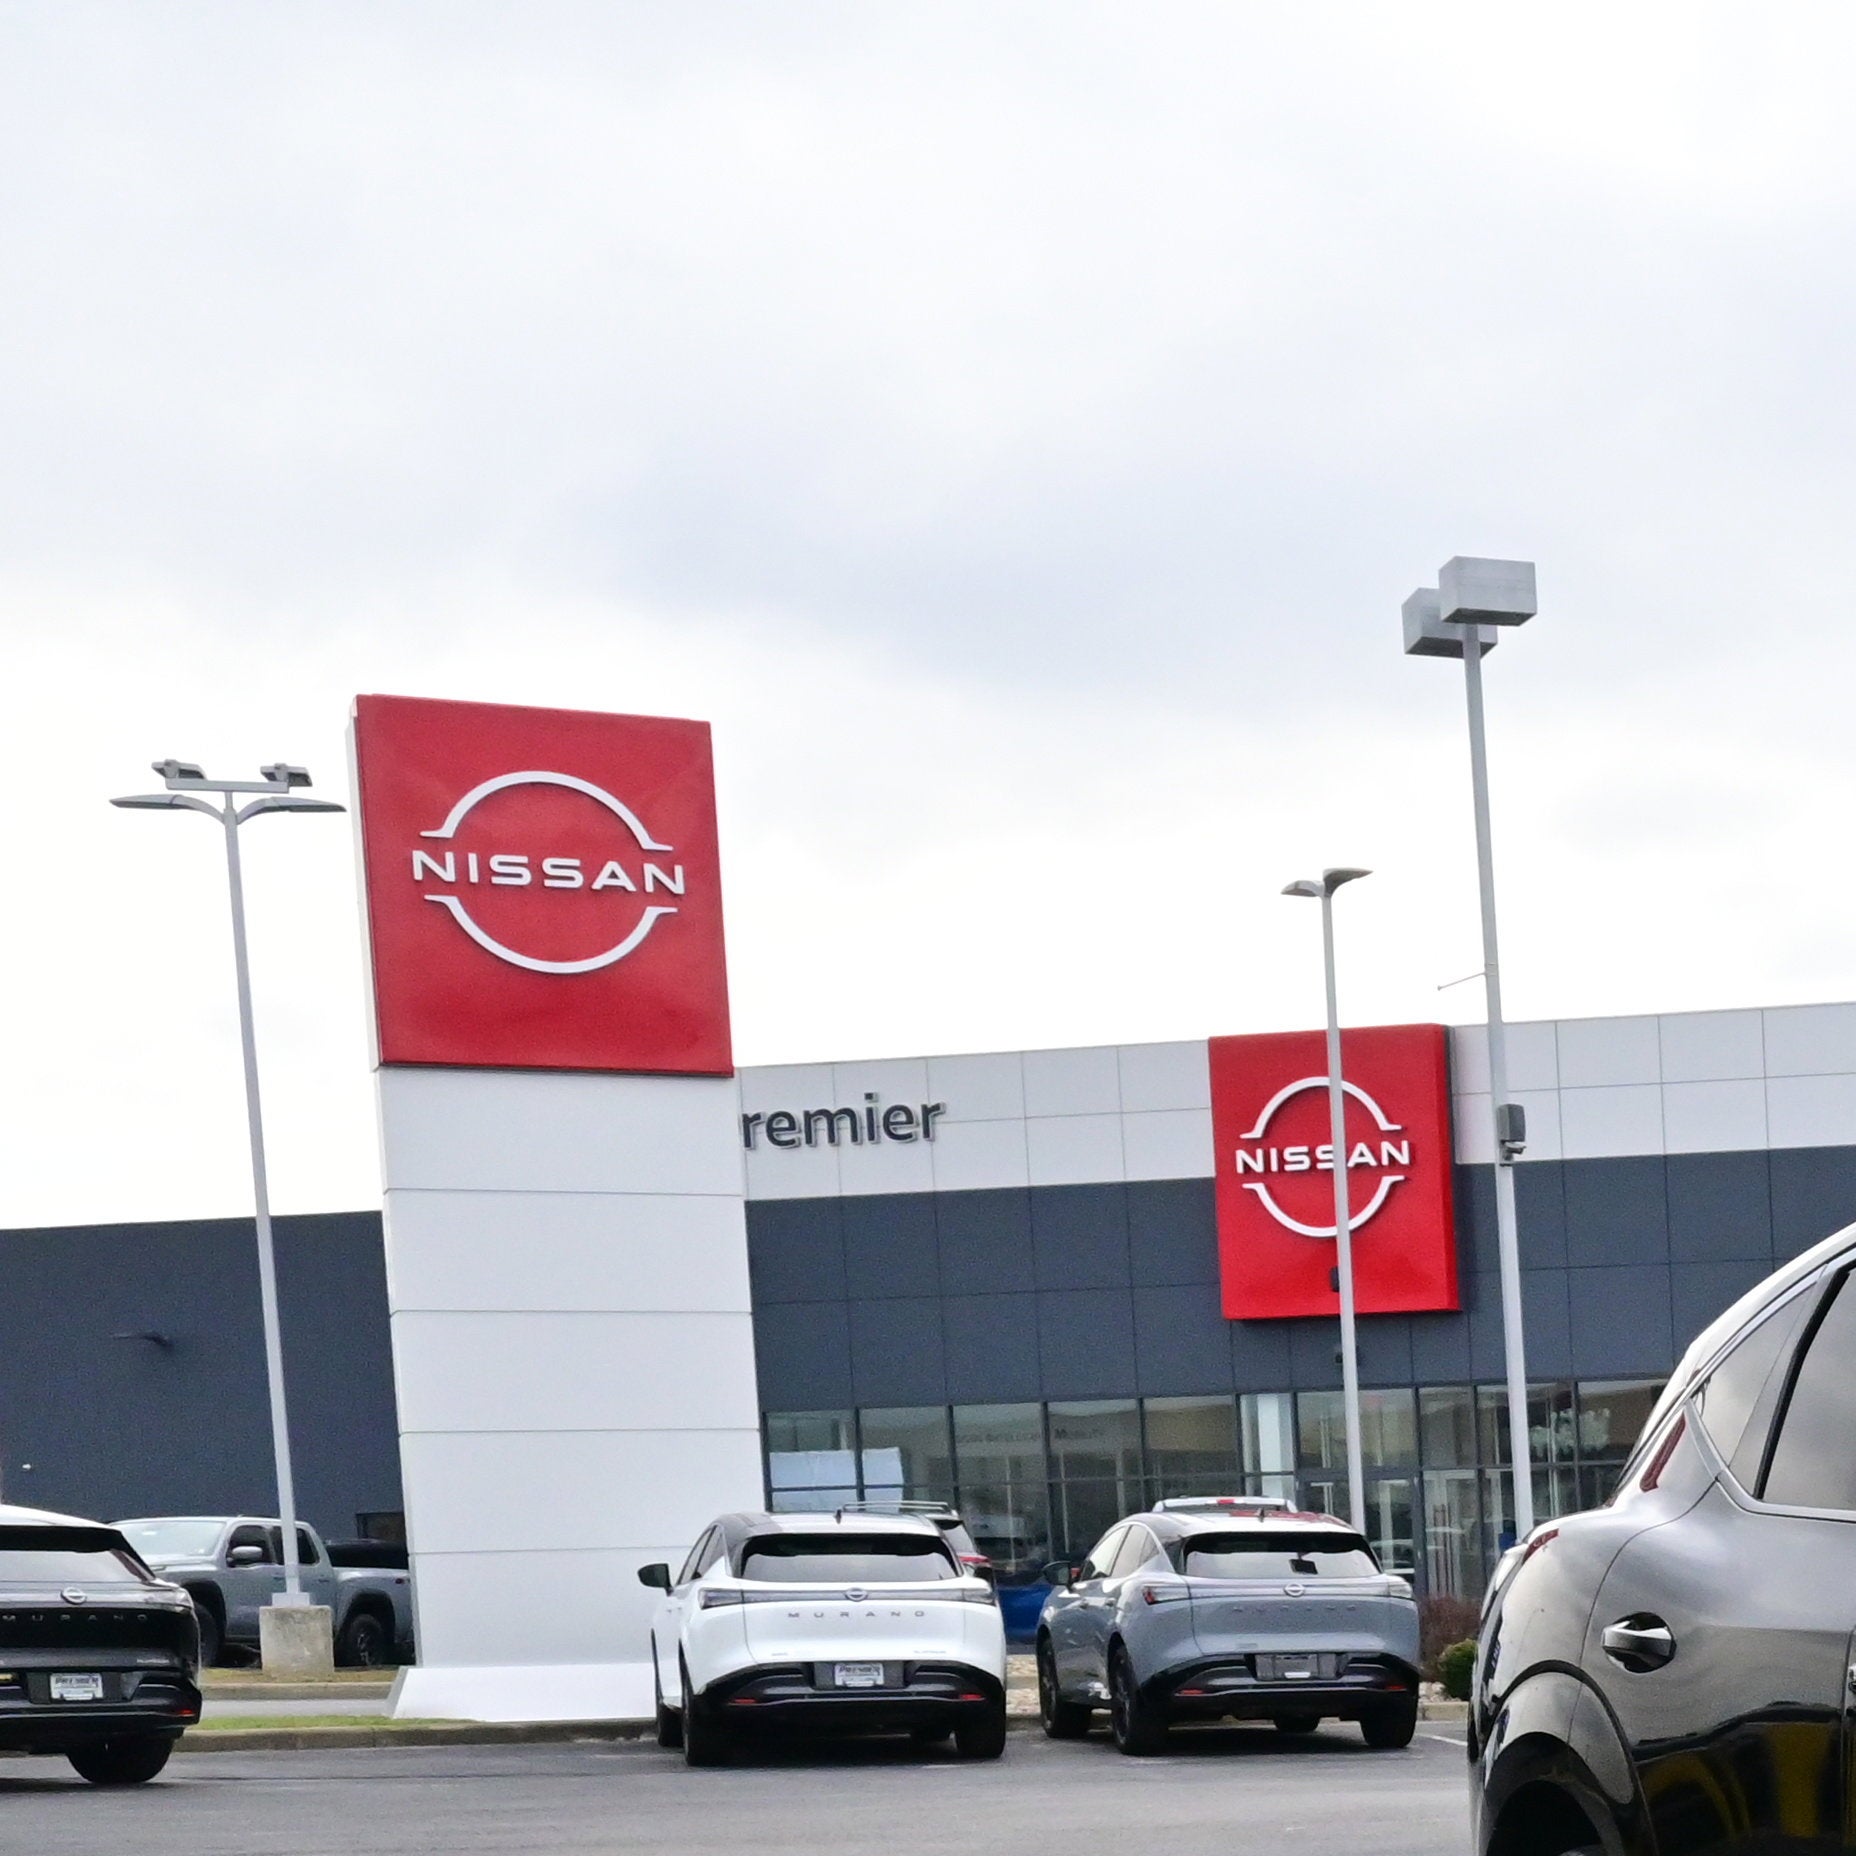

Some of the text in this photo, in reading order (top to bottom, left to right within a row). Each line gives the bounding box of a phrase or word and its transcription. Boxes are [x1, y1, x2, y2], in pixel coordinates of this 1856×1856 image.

[412, 850, 685, 894] NISSAN
[742, 1092, 946, 1148] remier
[1235, 1140, 1410, 1174] NISSAN
[787, 1610, 926, 1619] MURANO
